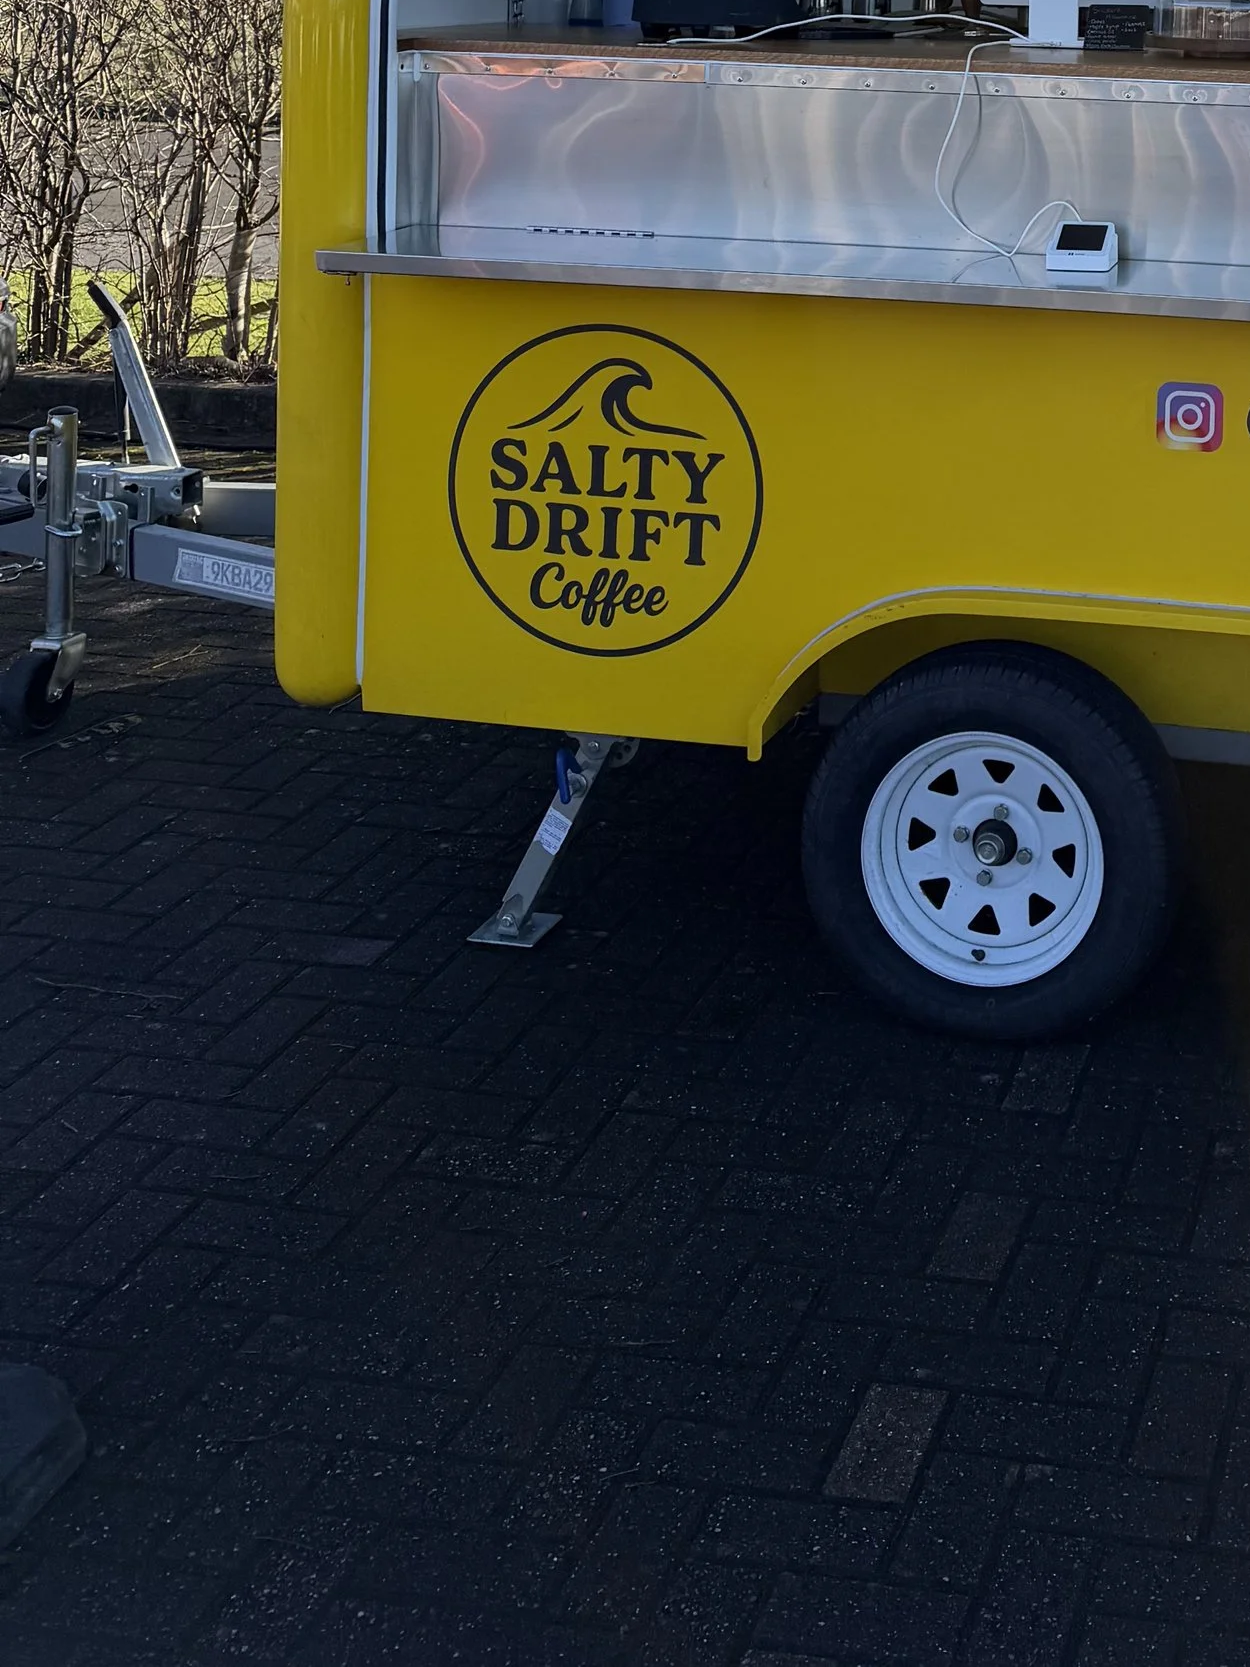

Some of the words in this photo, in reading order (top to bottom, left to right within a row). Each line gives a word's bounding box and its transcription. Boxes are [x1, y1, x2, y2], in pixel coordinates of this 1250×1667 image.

[490, 438, 725, 504] SALTY
[492, 498, 721, 566] DRIFT
[530, 563, 669, 627] Coffee
